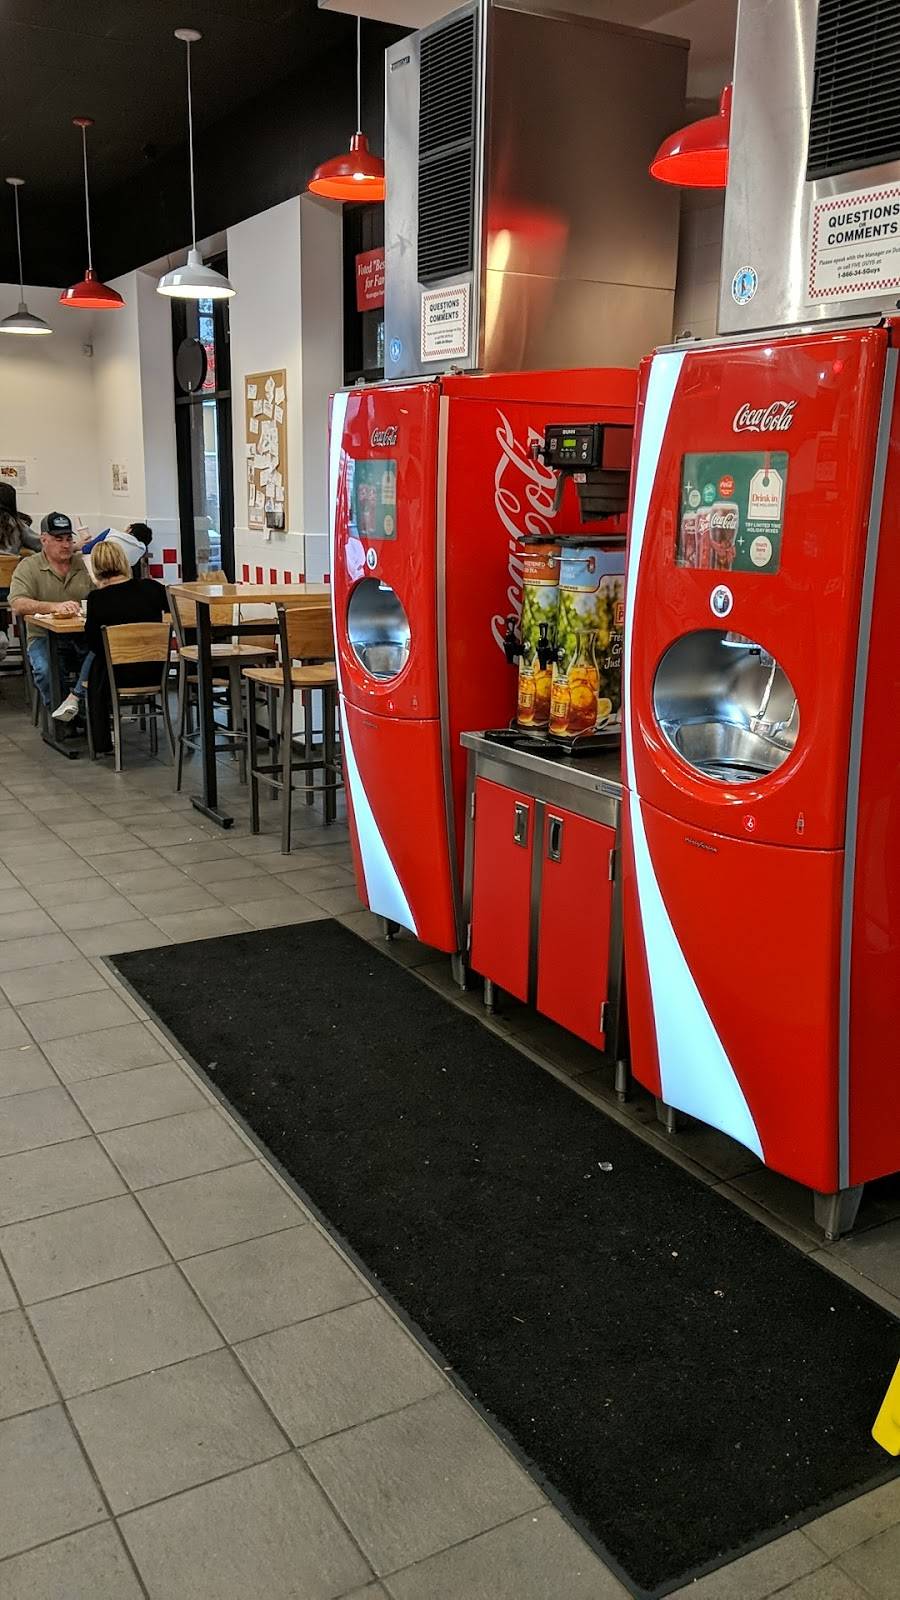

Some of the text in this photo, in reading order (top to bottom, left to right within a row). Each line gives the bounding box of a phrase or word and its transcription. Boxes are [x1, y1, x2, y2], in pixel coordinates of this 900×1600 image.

[829, 204, 900, 228] QUESTIONS
[827, 222, 898, 245] COMMENTS
[833, 257, 846, 265] speak
[865, 250, 885, 258] Manager
[358, 261, 373, 276] Voted
[364, 277, 374, 293] for
[429, 299, 460, 311] QUESTIONS
[429, 310, 459, 323] COMMENTS
[752, 494, 770, 502] Drink
[604, 656, 621, 670] Just
